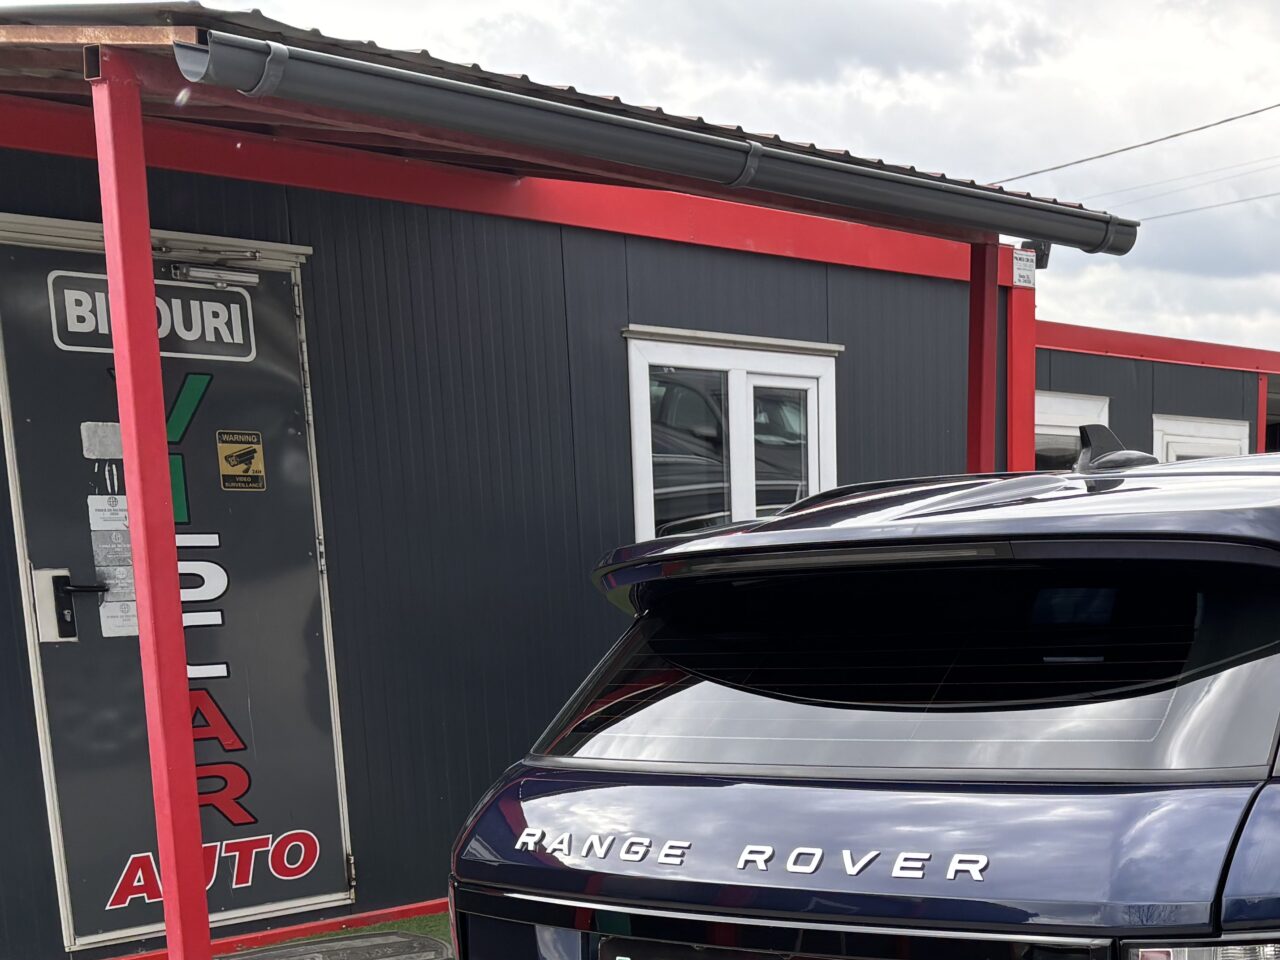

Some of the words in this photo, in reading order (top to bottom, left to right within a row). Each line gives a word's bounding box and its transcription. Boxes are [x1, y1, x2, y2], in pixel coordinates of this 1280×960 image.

[222, 433, 257, 443] WARNING
[515, 828, 691, 866] RANGE
[736, 844, 989, 881] ROVER
